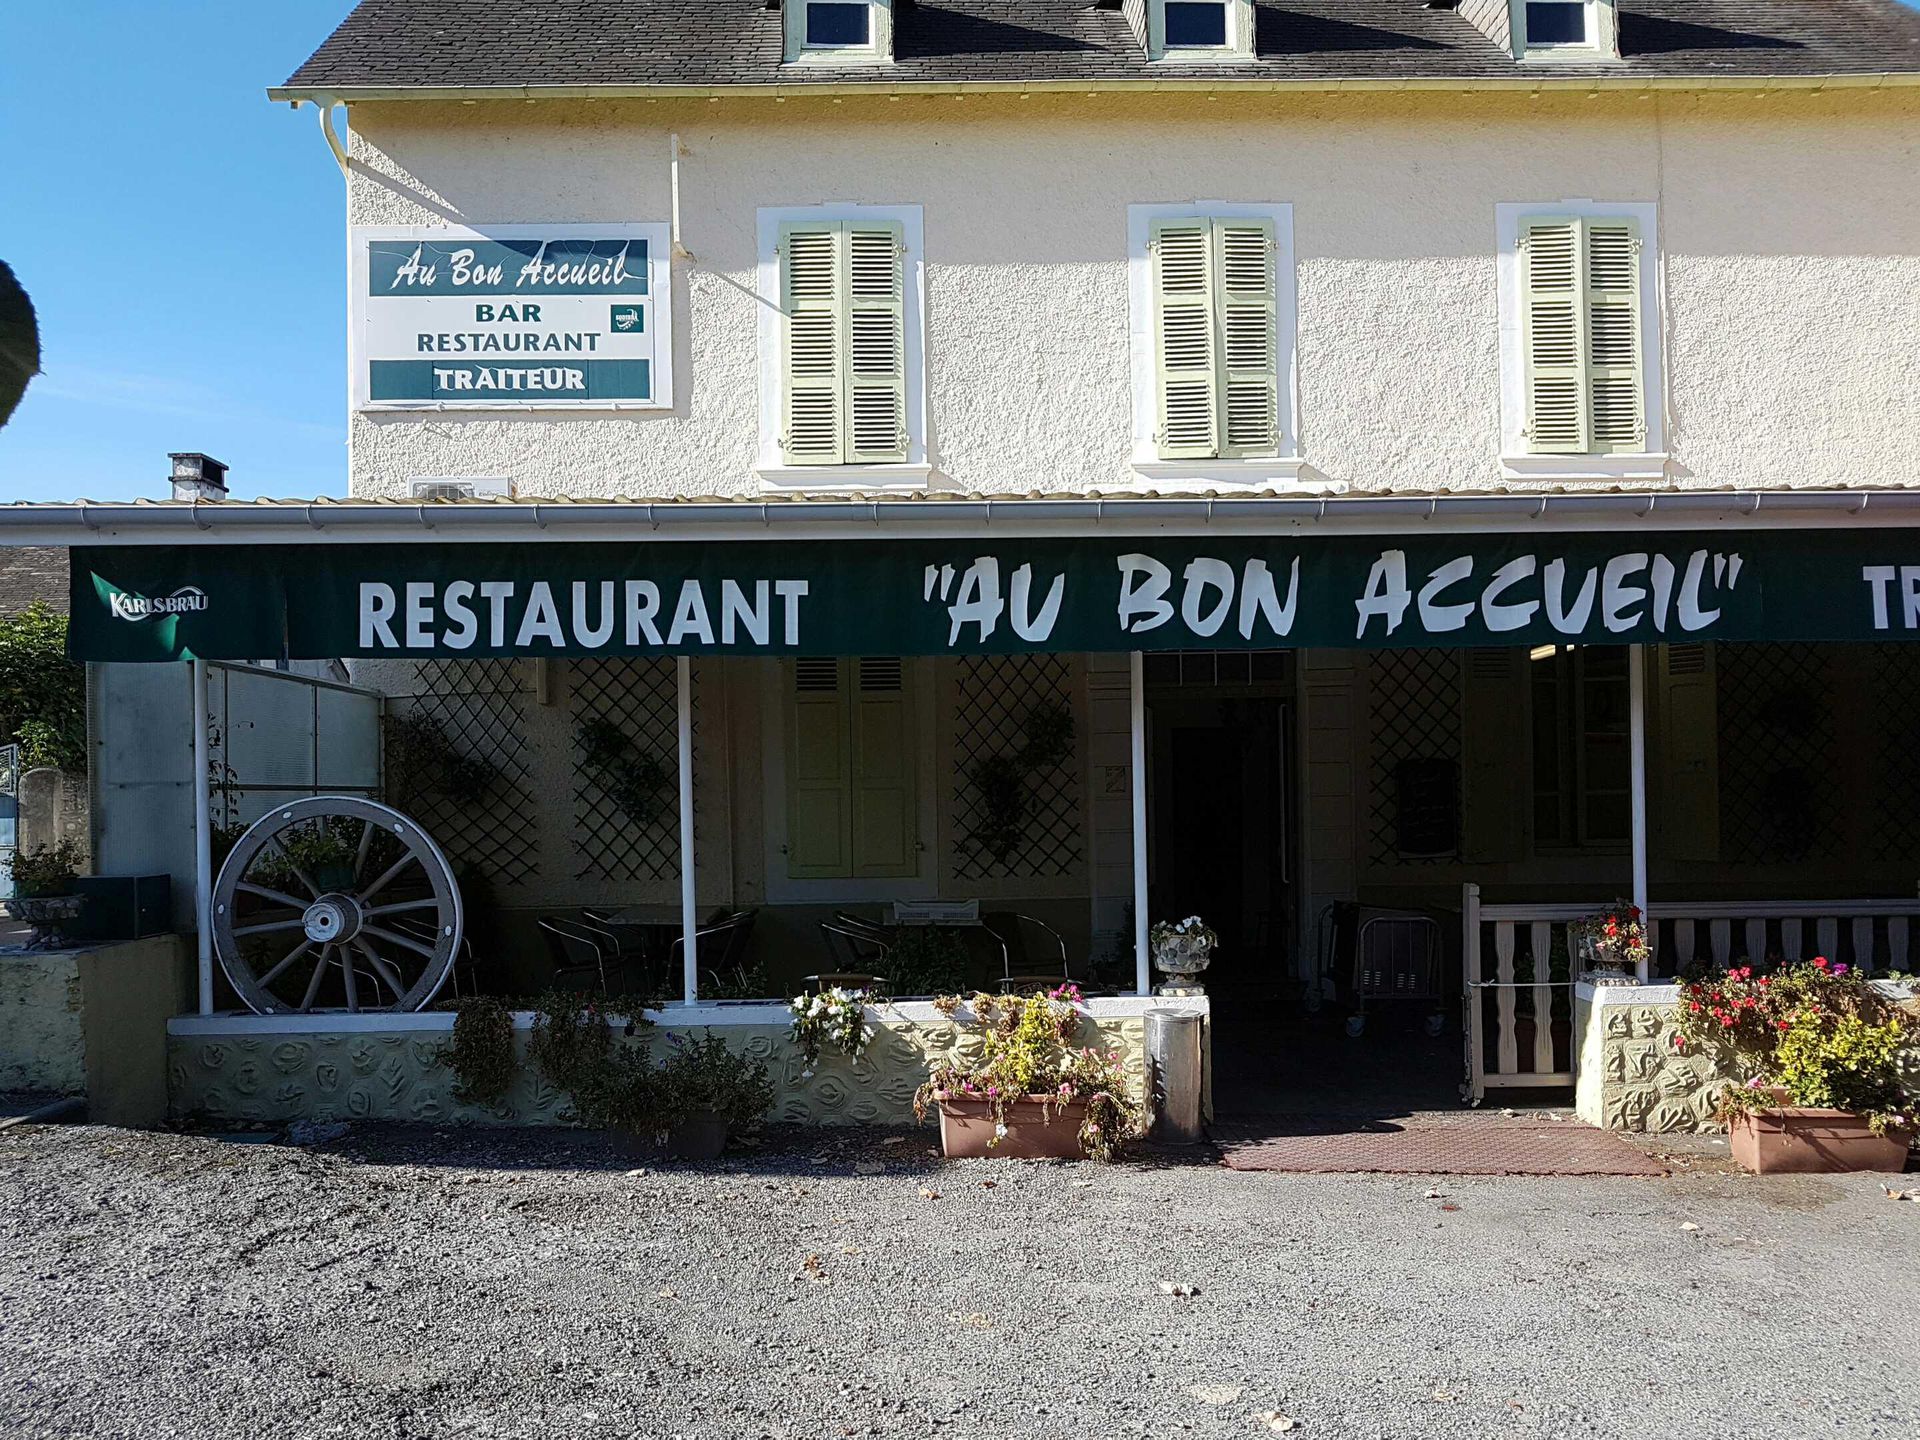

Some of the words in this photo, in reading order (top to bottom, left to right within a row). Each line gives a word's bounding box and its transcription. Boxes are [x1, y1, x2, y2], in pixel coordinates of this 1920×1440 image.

[389, 242, 437, 290] Au
[451, 248, 505, 287] Bon
[515, 241, 627, 288] Accueil
[475, 303, 542, 323] BAR
[417, 333, 601, 353] RESTAURANT
[433, 367, 586, 391] TRAITEUR
[359, 579, 809, 650] RESTAURANT
[924, 555, 1065, 647] "AU
[1117, 553, 1300, 641] BON
[1354, 549, 1744, 638] ACCUEIL"
